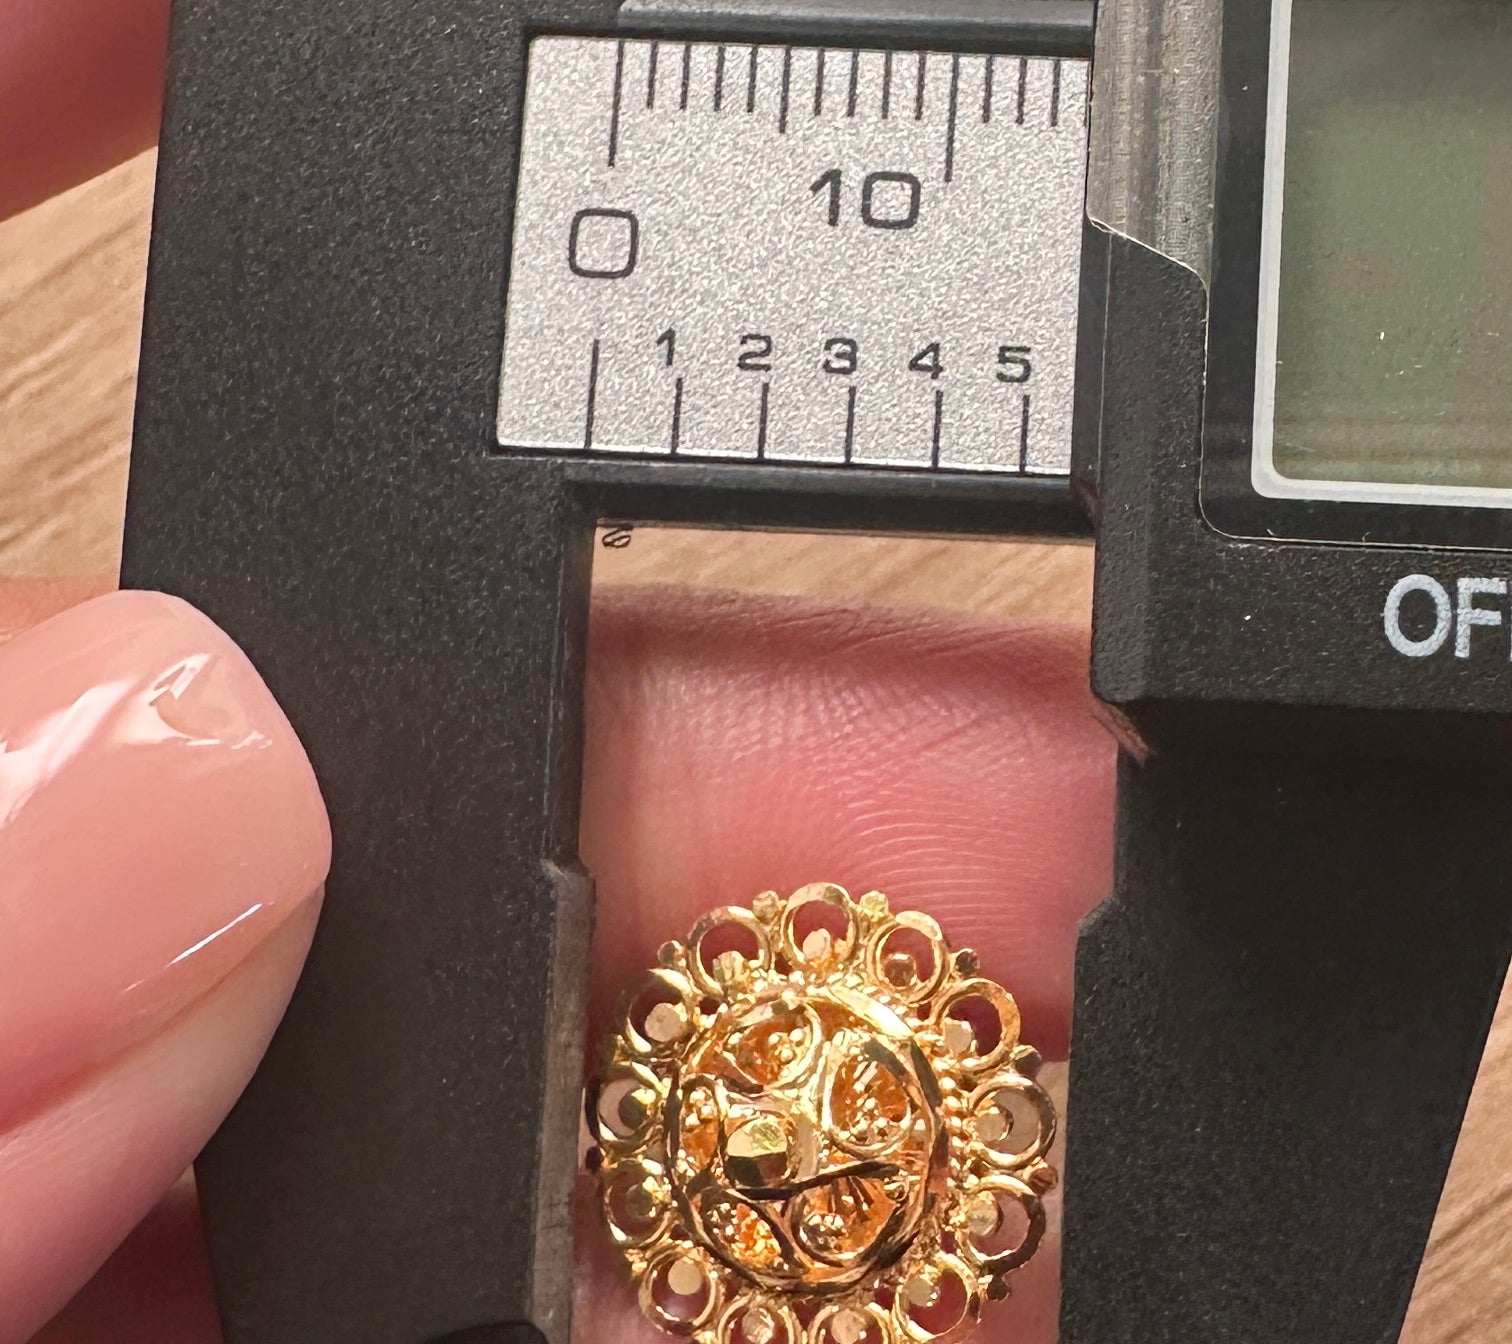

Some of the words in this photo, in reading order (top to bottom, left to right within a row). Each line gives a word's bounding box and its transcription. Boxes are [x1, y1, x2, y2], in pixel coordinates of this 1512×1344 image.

[810, 169, 921, 230] 10
[568, 208, 639, 279] 0
[656, 328, 677, 366] 1
[737, 333, 773, 372] 2
[822, 337, 858, 374] 3
[908, 342, 944, 380] 4
[996, 345, 1033, 383] 5
